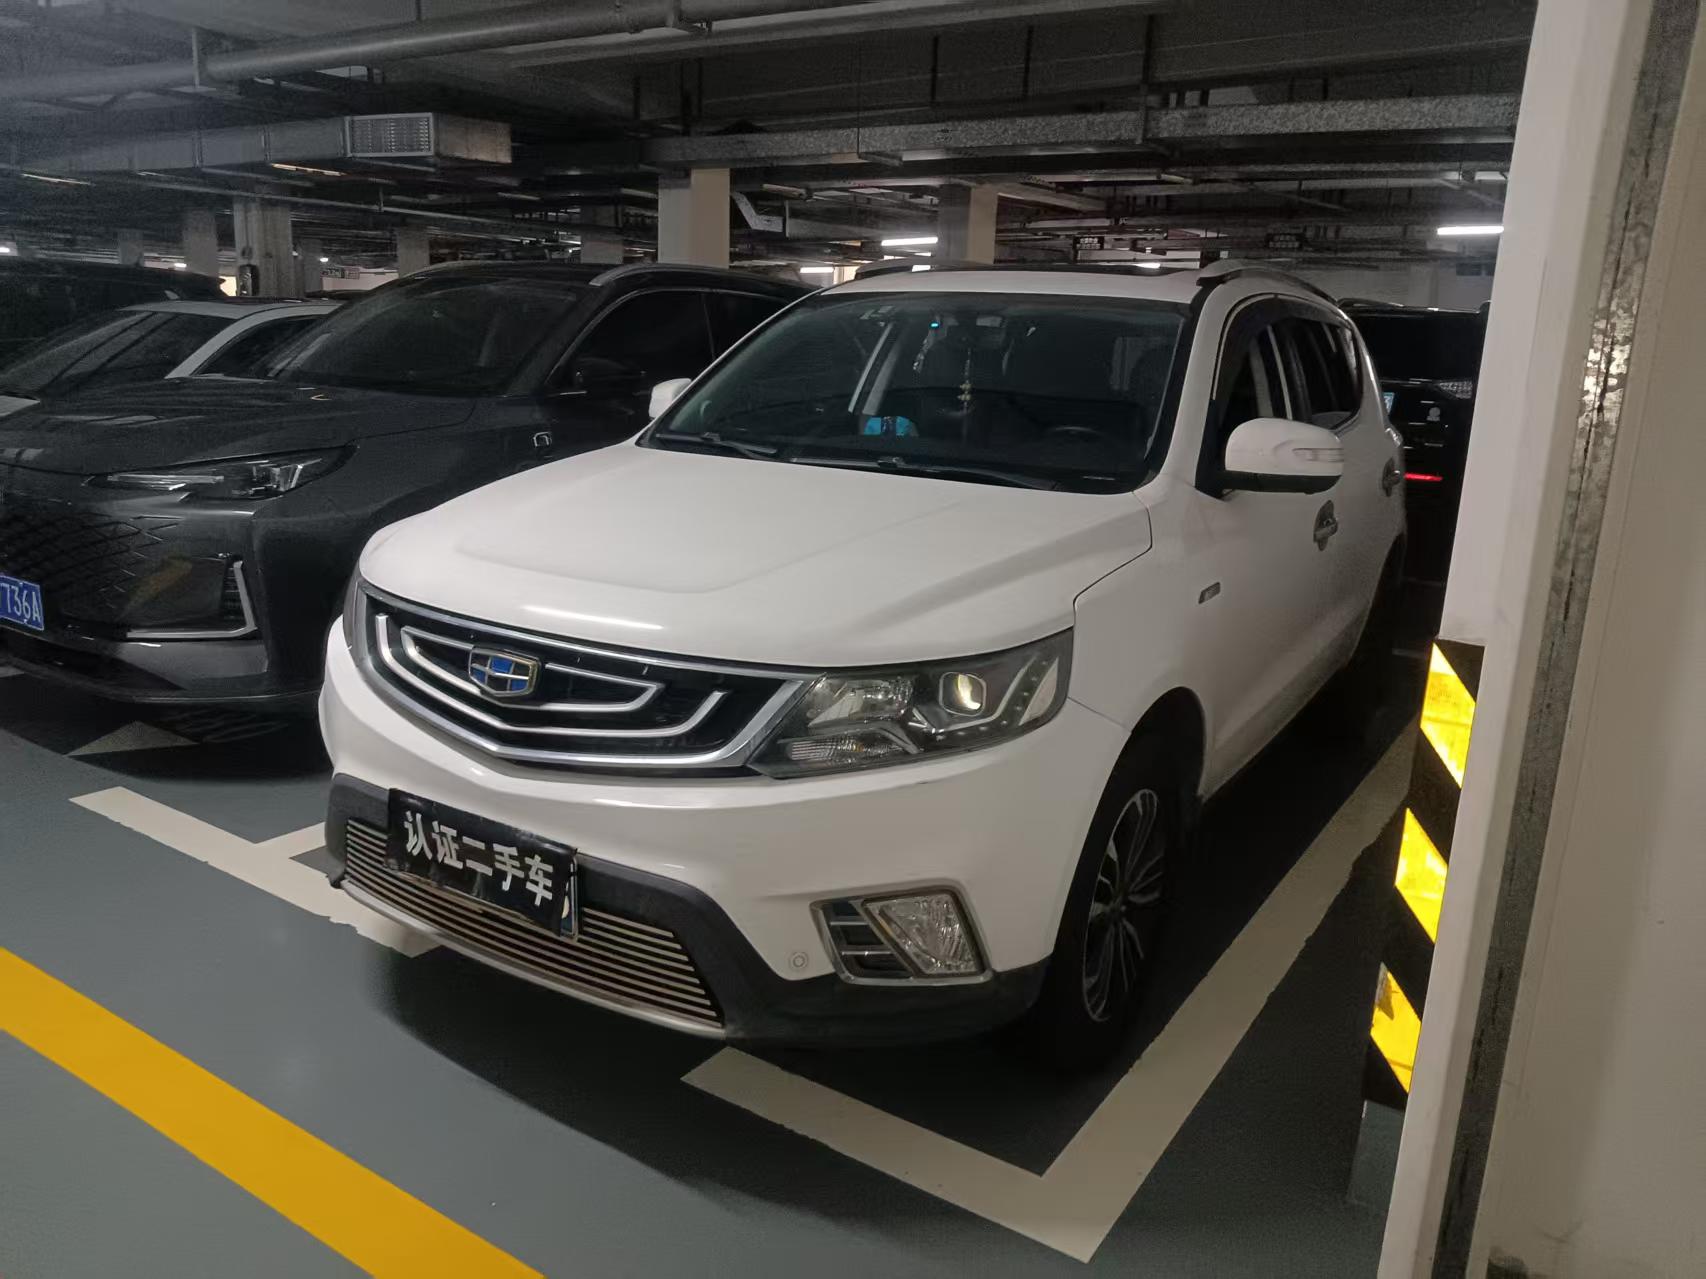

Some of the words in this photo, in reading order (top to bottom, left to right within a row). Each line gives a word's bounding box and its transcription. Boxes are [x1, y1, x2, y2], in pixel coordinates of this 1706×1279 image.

[404, 810, 554, 907] 认证二手车
